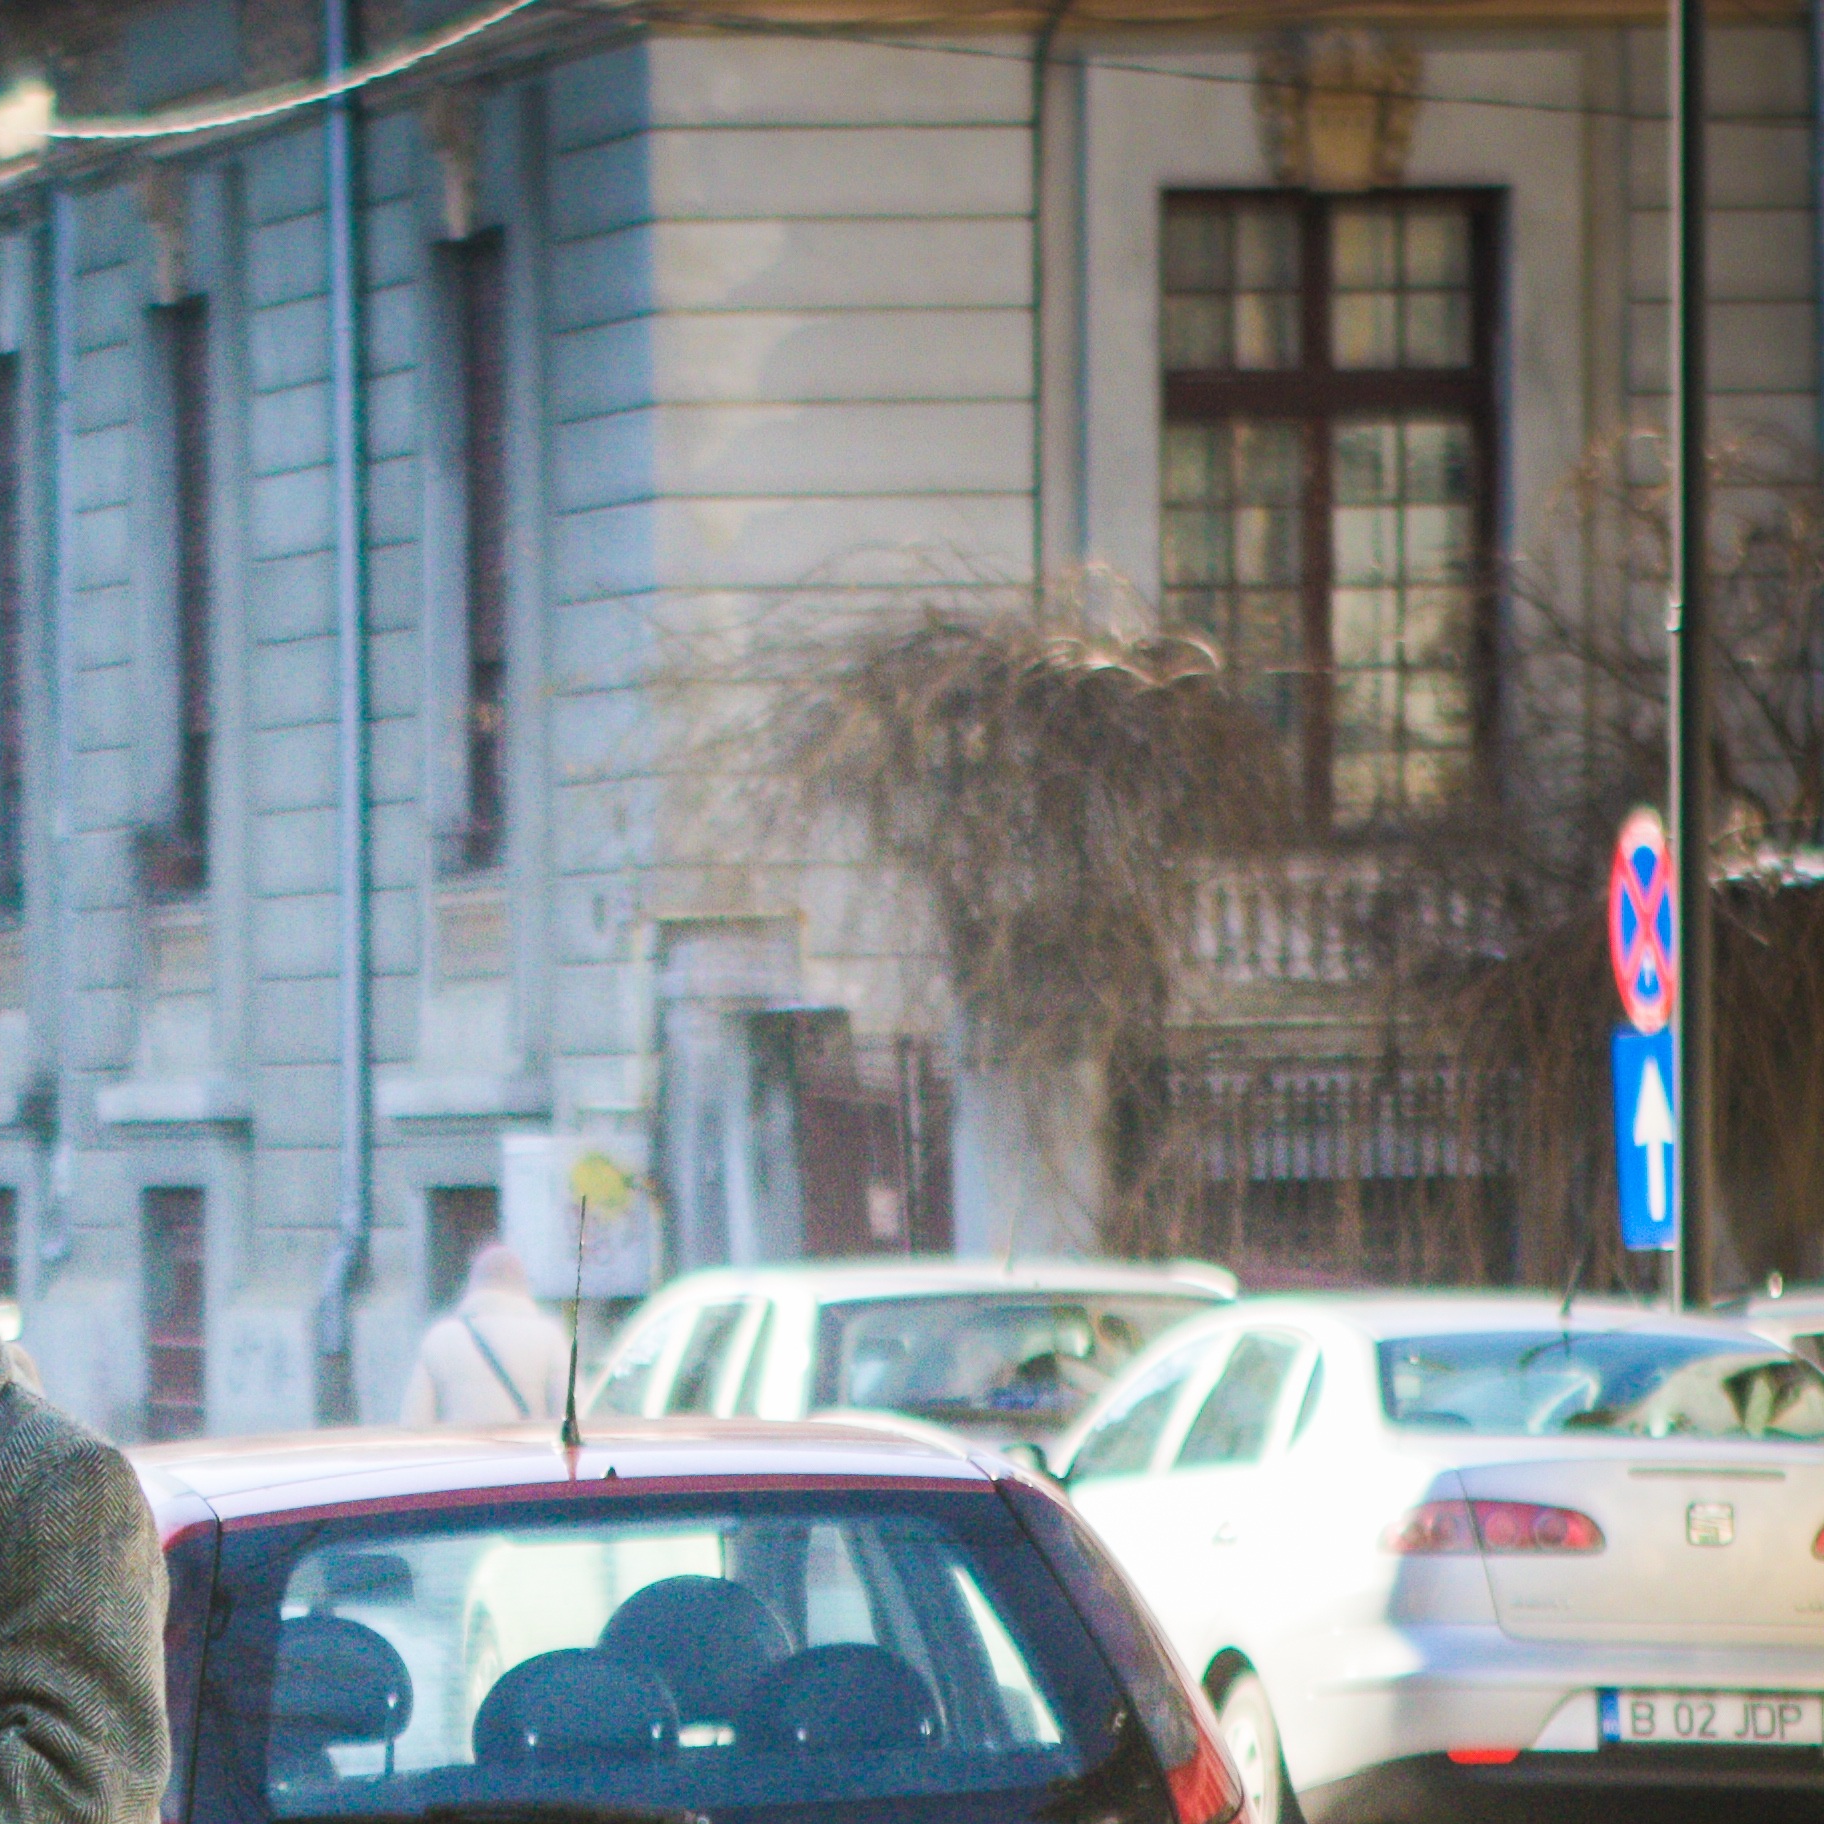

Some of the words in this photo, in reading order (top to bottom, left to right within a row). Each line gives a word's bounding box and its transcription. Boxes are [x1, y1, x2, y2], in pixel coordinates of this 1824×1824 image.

[1631, 1699, 1655, 1738] B
[1673, 1700, 1718, 1739] 02
[1735, 1702, 1802, 1741] JDP
